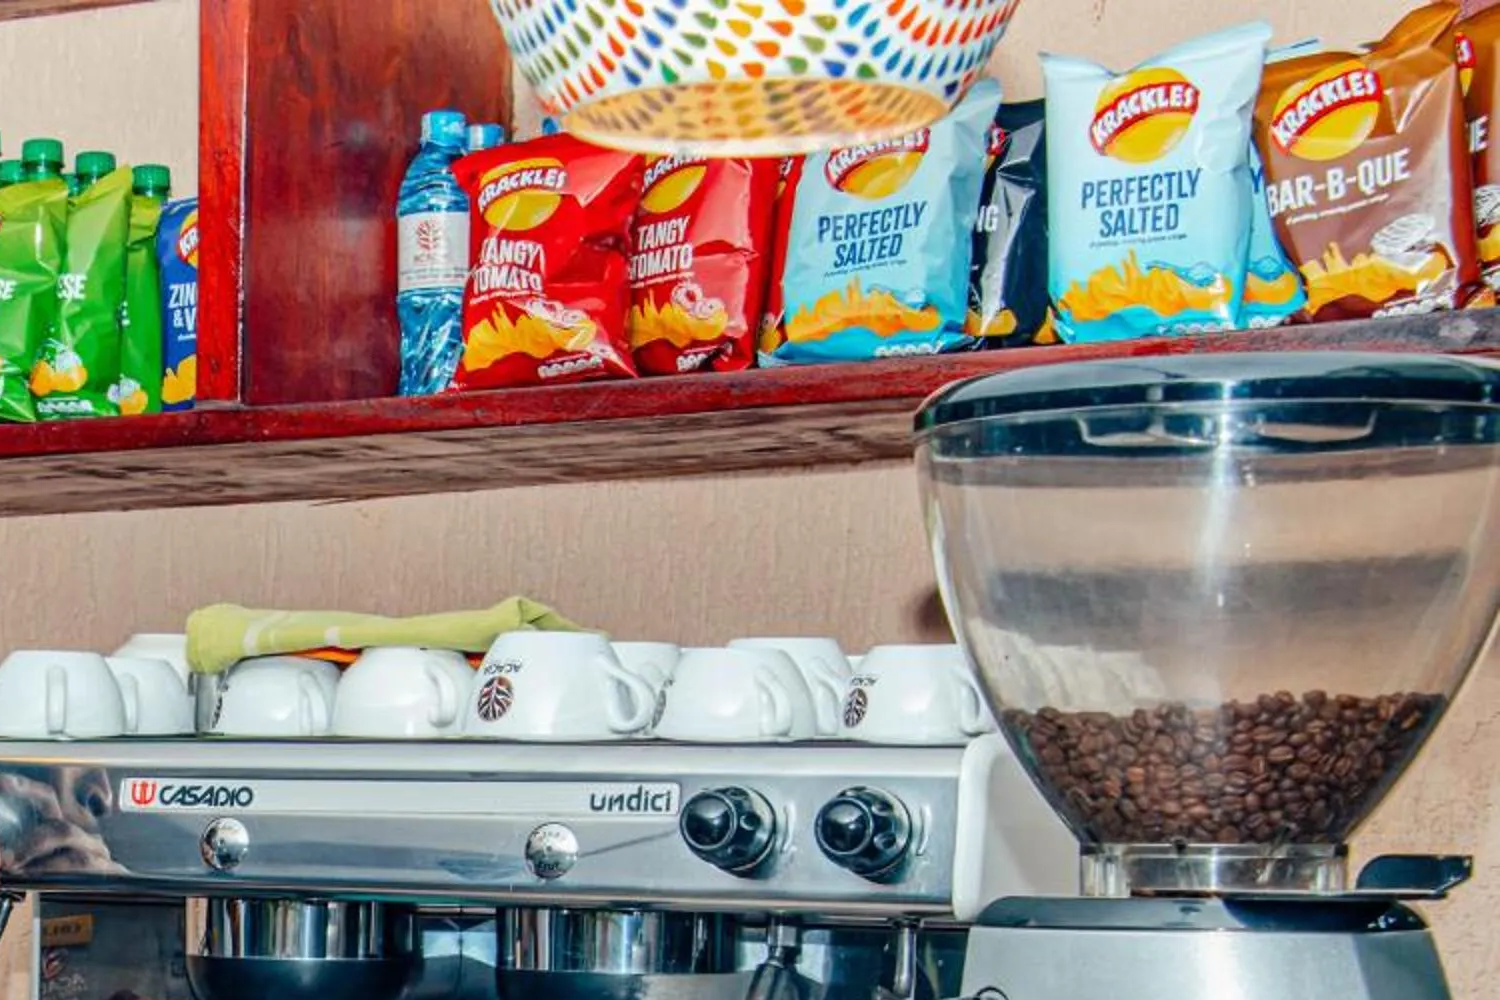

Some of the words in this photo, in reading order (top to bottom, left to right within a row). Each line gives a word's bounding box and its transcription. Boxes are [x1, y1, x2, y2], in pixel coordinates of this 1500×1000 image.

[1091, 85, 1194, 148] KRACKLES
[1272, 71, 1377, 147] KRACKLES
[478, 167, 566, 213] KRACKLES
[1081, 167, 1203, 210] PERFECTLY
[1265, 147, 1412, 218] BAR-B-QUE
[637, 216, 690, 250] TANGY
[817, 201, 927, 243] PERFECTLY
[1100, 203, 1180, 238] SALTED
[481, 237, 542, 269] TANGY
[629, 243, 693, 281] TOMATO
[834, 233, 903, 269] SALTED
[168, 282, 197, 309] ZIN
[473, 264, 544, 295] TOMATO
[173, 309, 184, 328] &
[159, 785, 253, 807] CASADIO
[590, 785, 671, 812] undici
